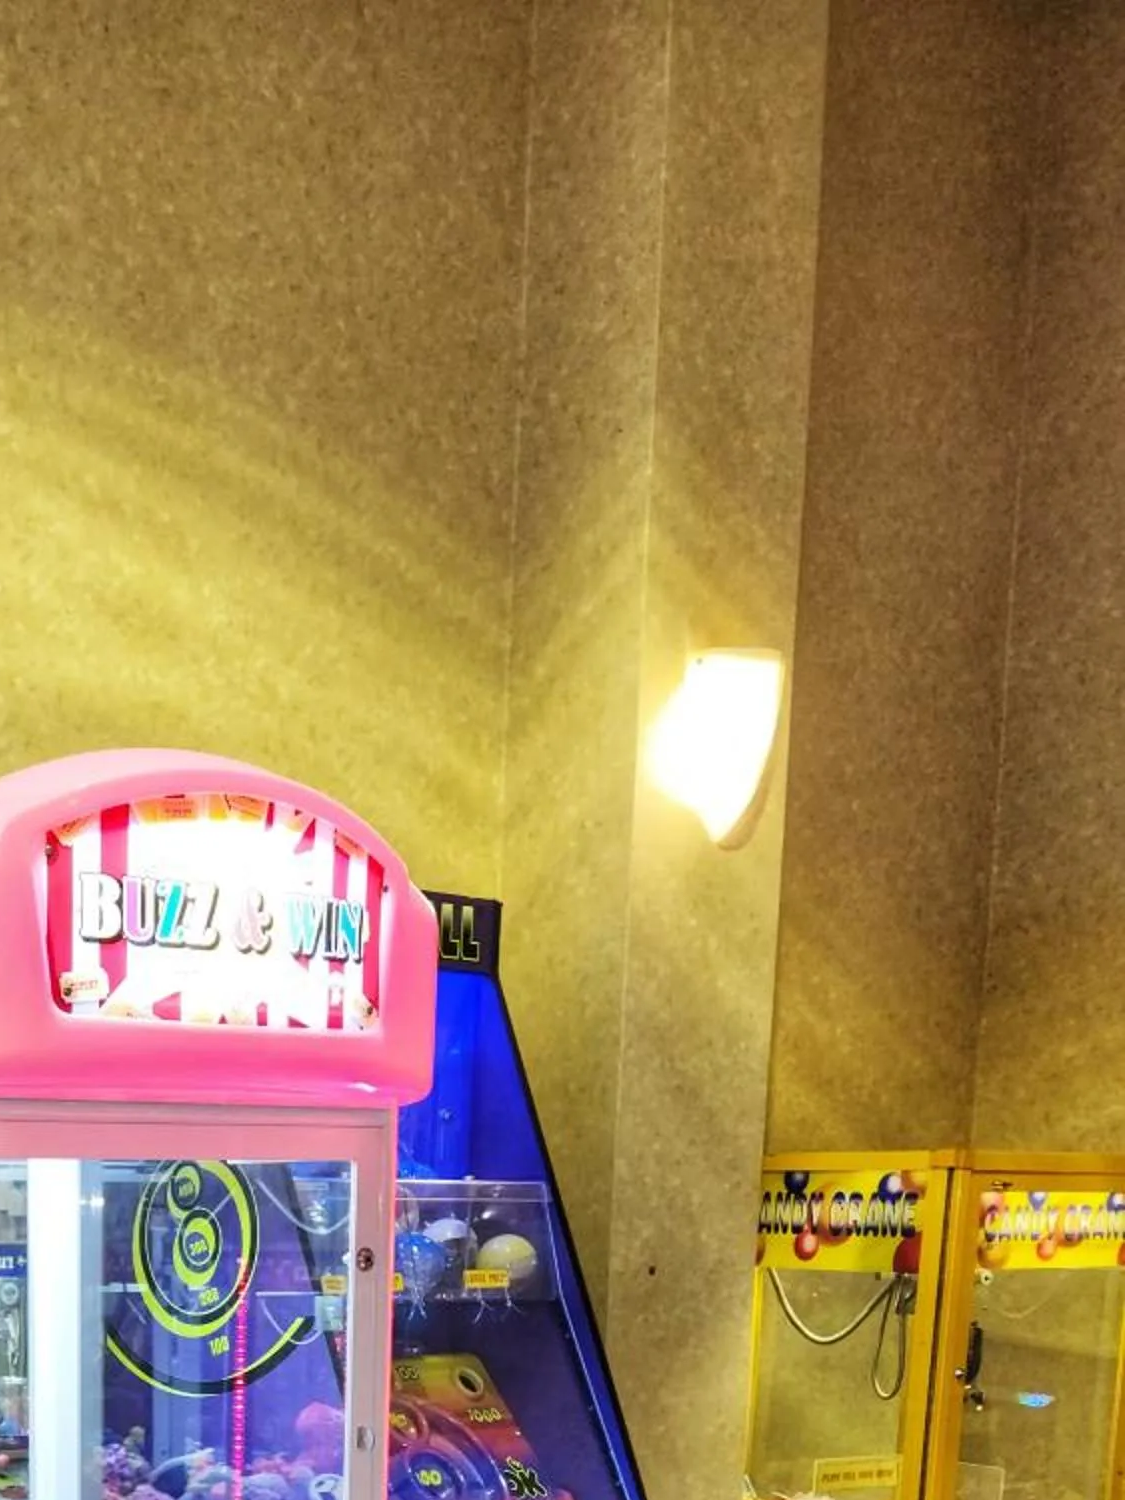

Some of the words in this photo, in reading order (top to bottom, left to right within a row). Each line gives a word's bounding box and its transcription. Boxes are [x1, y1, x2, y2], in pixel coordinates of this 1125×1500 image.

[80, 873, 219, 949] BUZZ
[234, 889, 272, 953] &
[285, 891, 364, 962] WIN
[758, 1191, 824, 1235] ANDY
[830, 1191, 919, 1238] CRANE
[985, 1205, 1059, 1243] CANDY
[1064, 1204, 1125, 1241] CRAN
